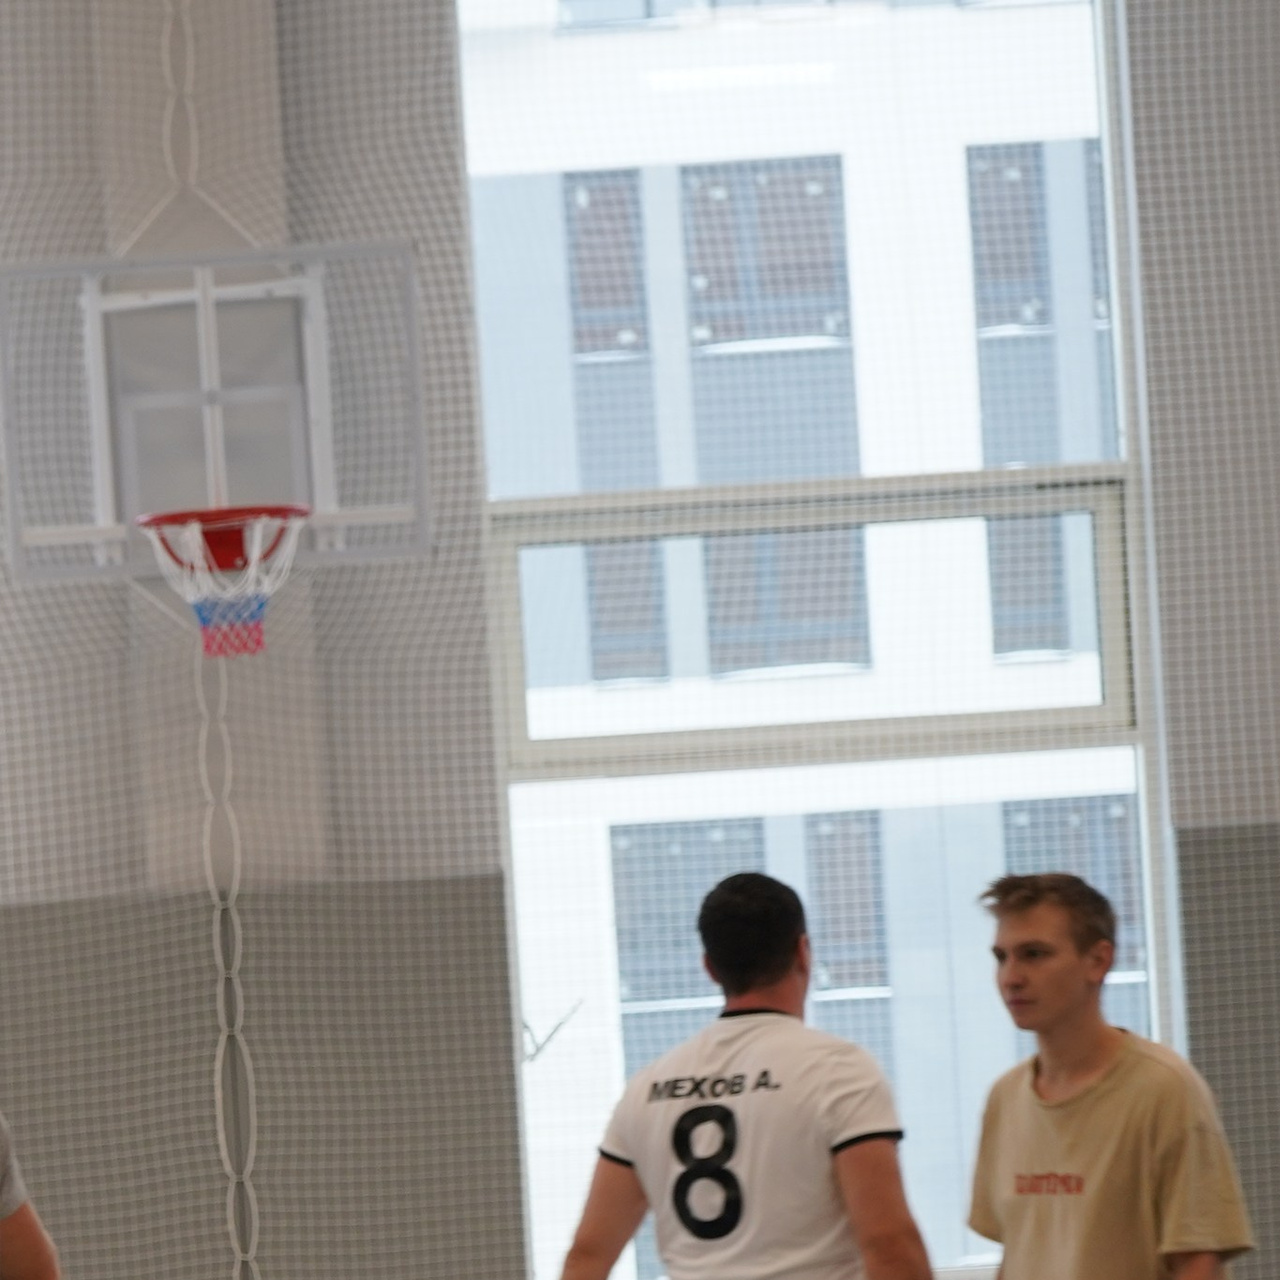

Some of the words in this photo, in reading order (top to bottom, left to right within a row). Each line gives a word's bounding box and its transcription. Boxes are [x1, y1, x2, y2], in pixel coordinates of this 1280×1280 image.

[648, 1074, 746, 1103] МЕХОВ
[752, 1070, 781, 1091] А.
[672, 1104, 742, 1240] 8
